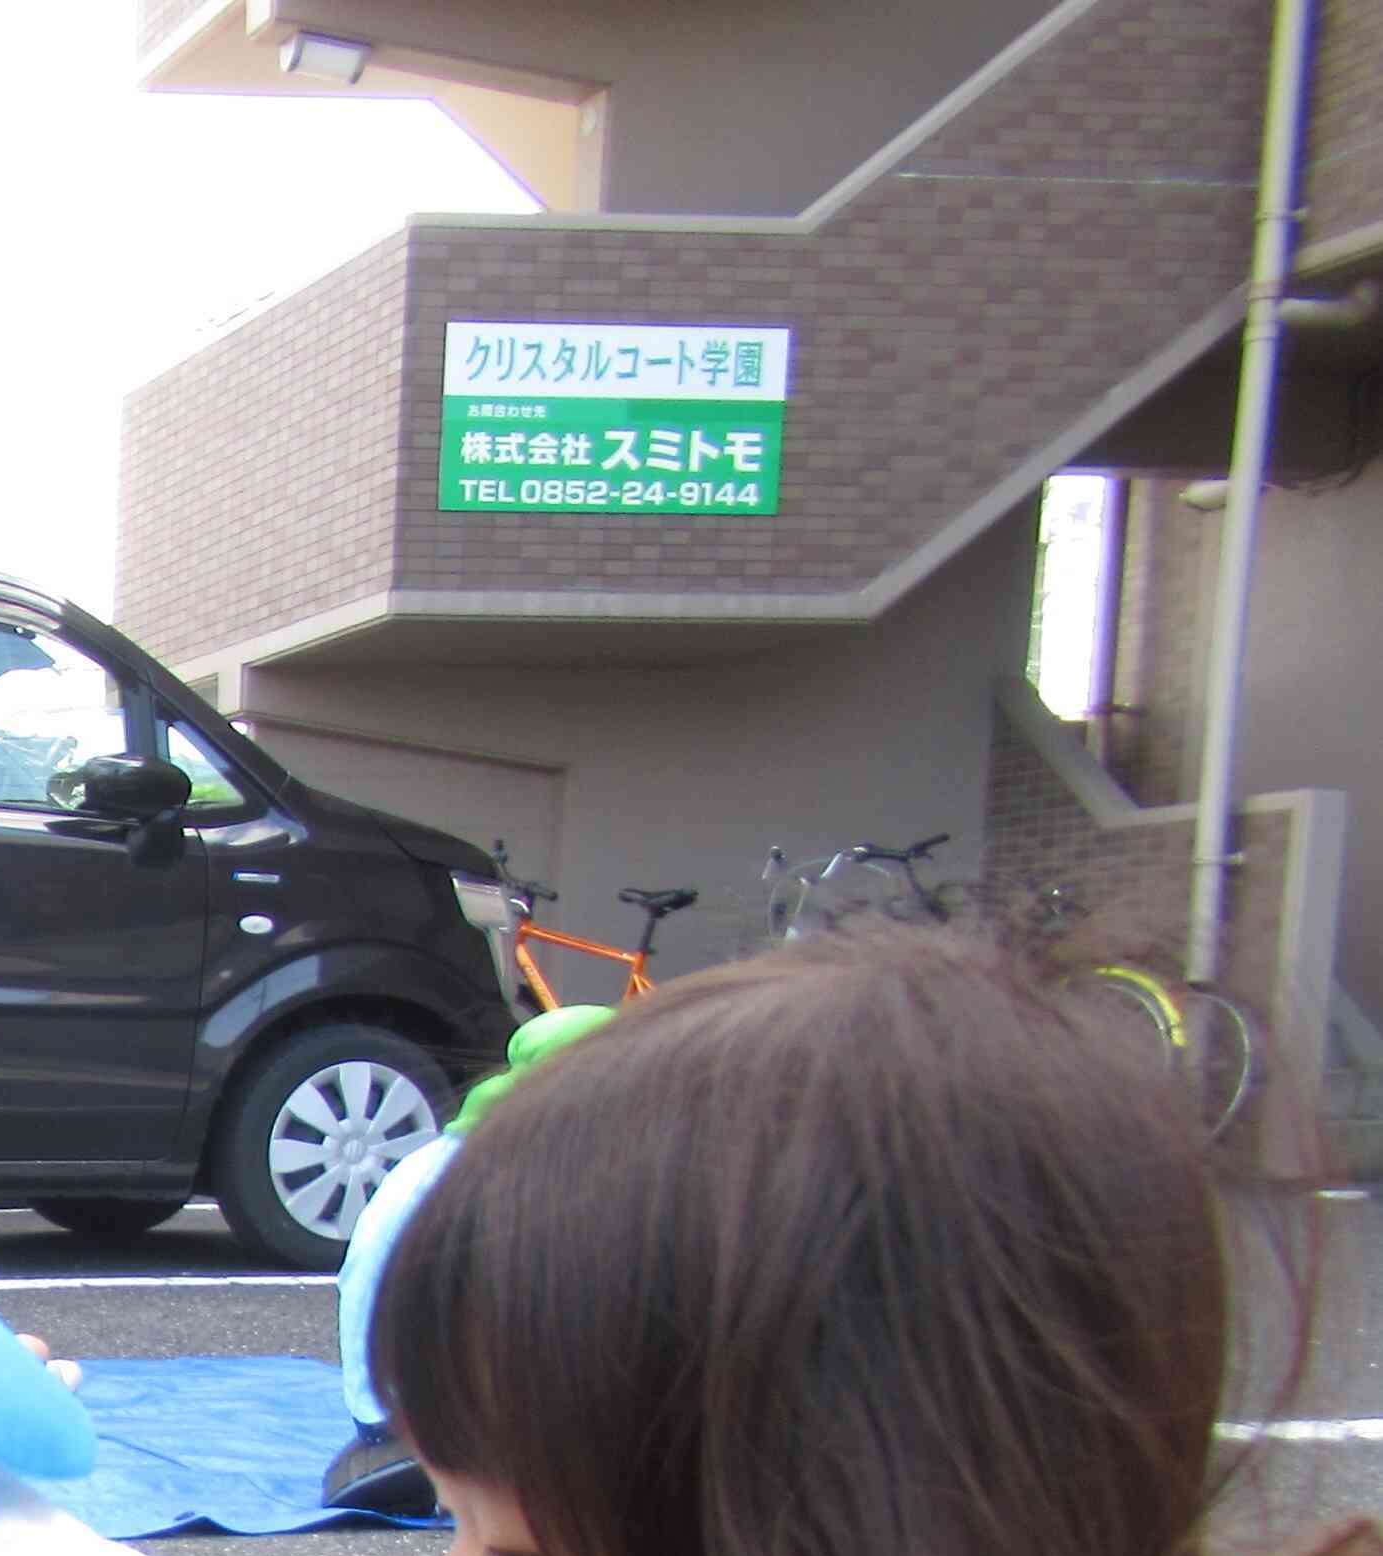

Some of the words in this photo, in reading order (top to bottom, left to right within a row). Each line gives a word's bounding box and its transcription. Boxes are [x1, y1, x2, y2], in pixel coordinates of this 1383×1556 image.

[466, 336, 765, 388] クリスタルコート学園
[460, 431, 592, 465] 株式会社
[600, 428, 763, 473] スミトモ
[459, 479, 515, 503] TEL
[520, 480, 760, 507] 0852-24-9144
